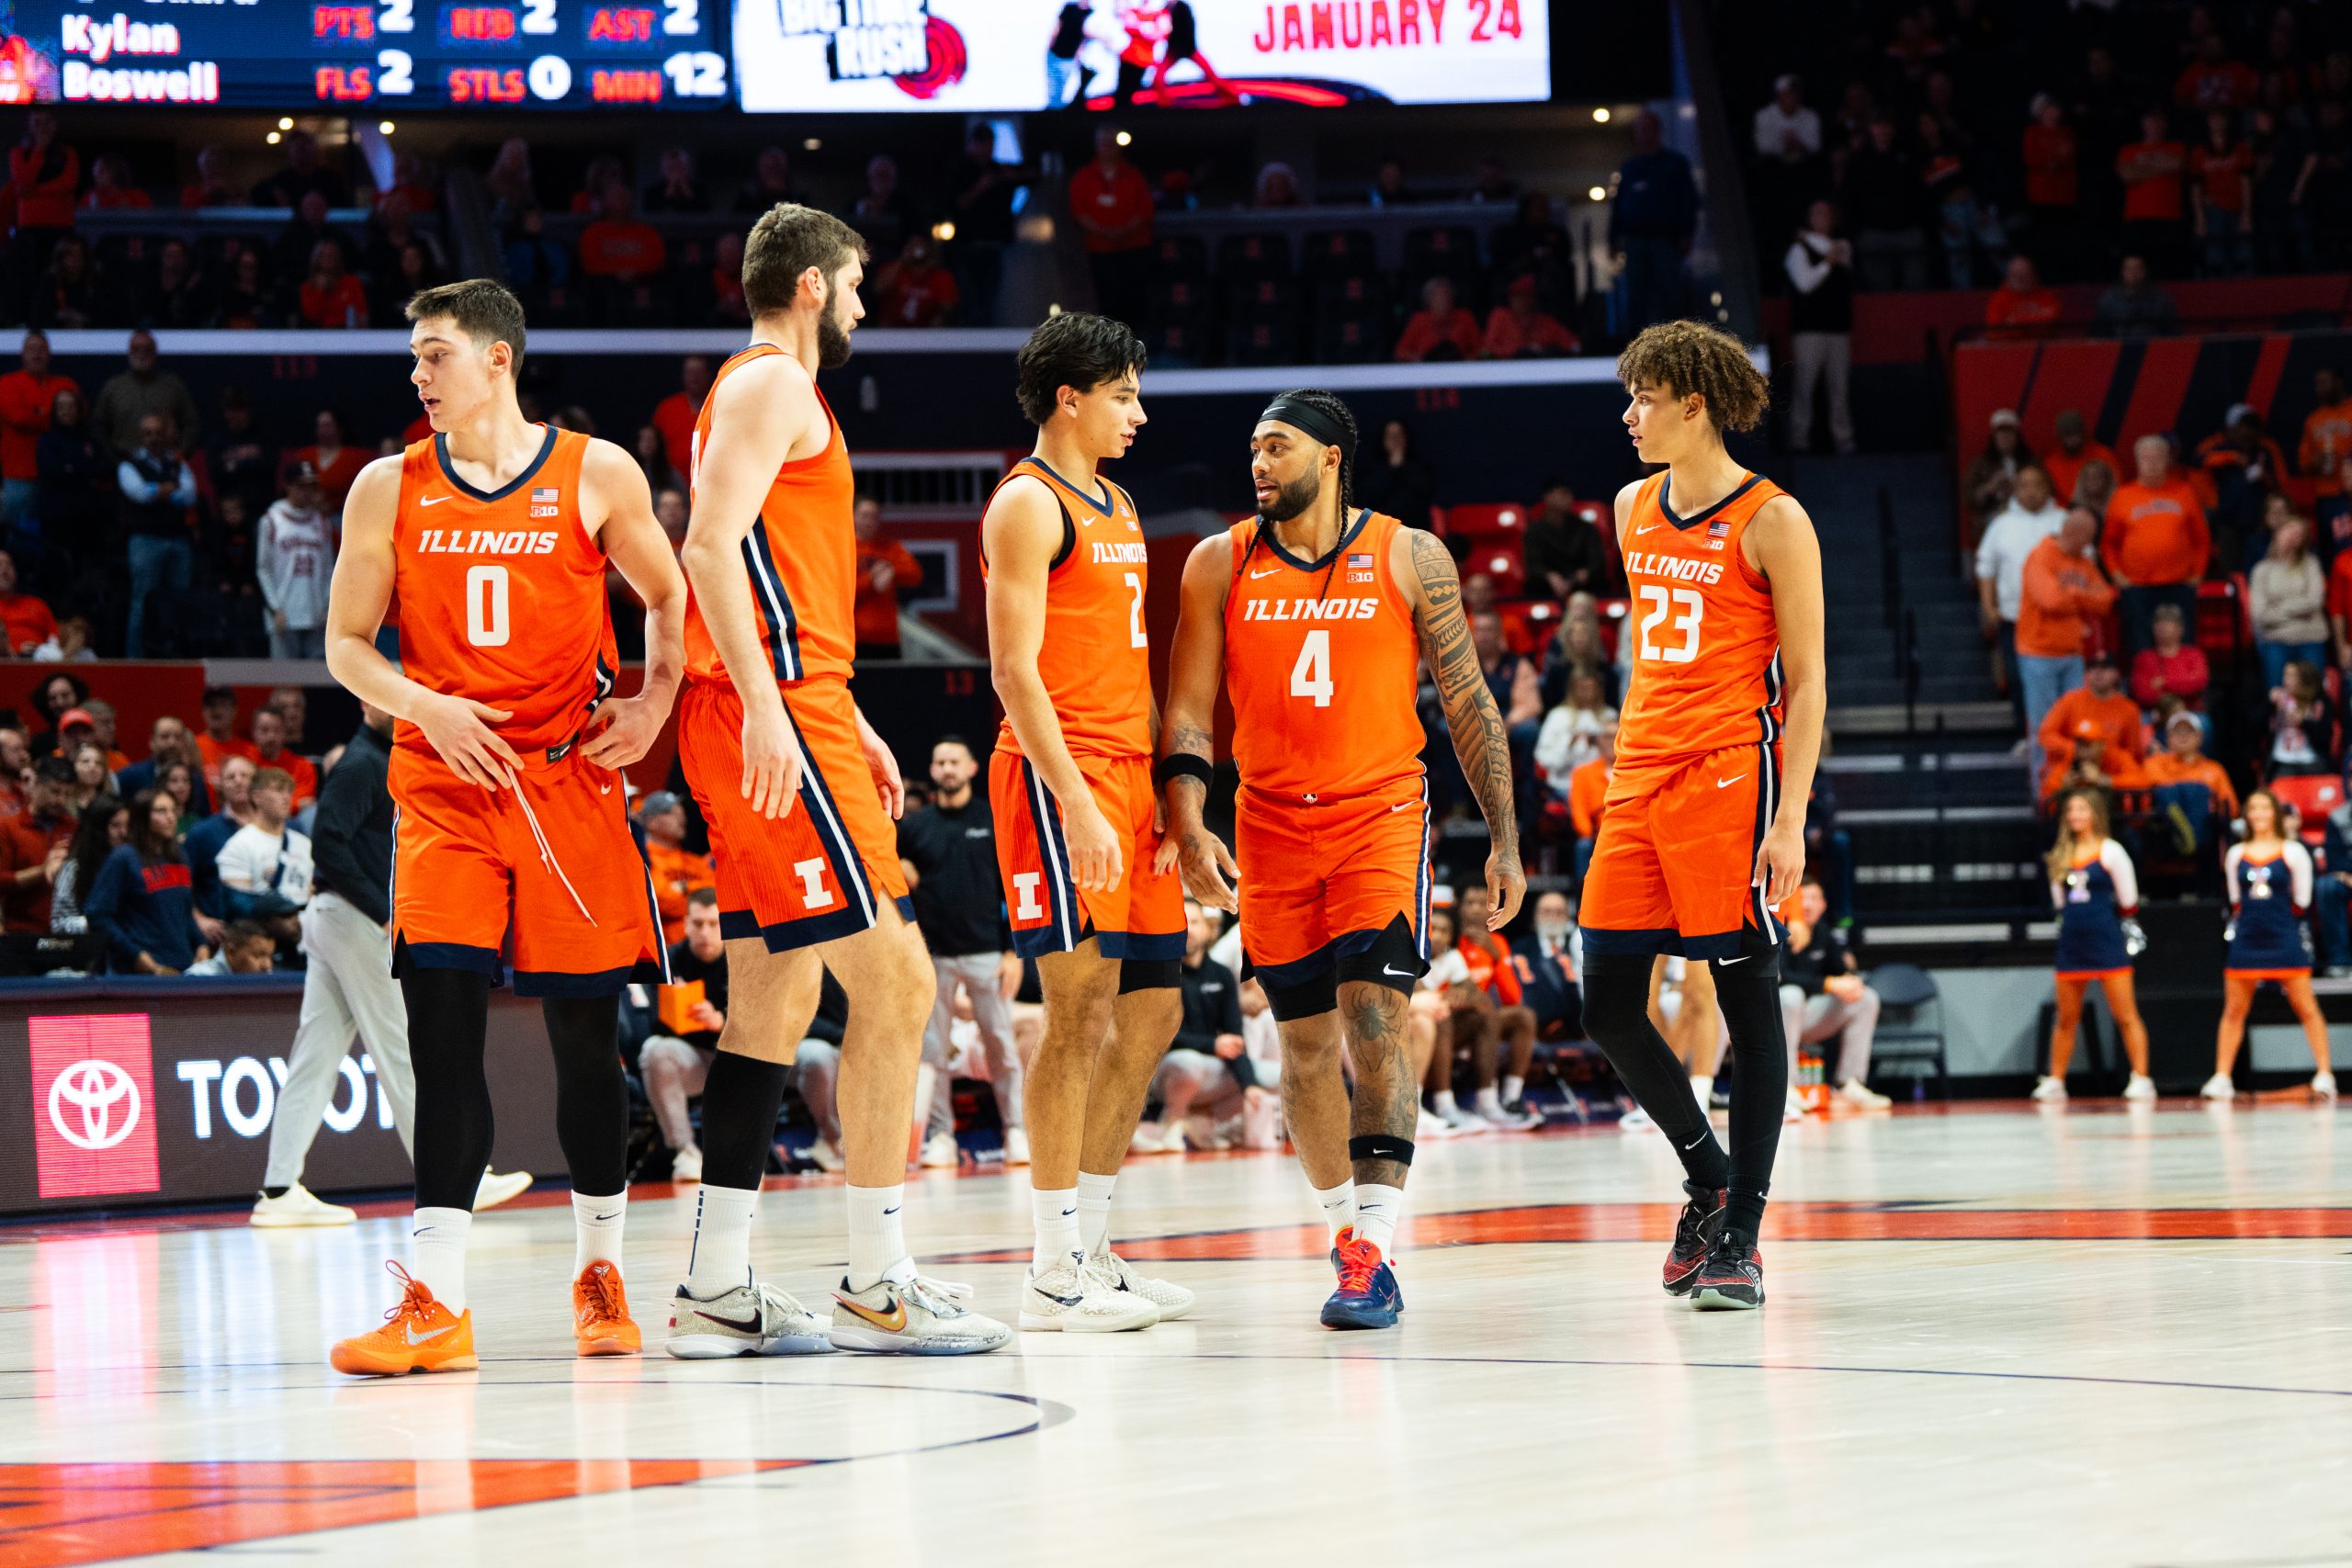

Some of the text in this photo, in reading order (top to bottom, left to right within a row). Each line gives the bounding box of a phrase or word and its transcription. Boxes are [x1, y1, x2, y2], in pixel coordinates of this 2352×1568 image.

[62, 13, 180, 63] Kylan
[314, 0, 413, 38] PTS 2
[450, 0, 557, 39] REB 2
[589, 0, 699, 40] AST 2
[1254, 0, 1521, 51] JANUARY 24
[316, 49, 413, 100] FLS 2
[835, 26, 927, 77] RUSH
[62, 61, 220, 103] Boswell
[449, 55, 571, 102] STLS 0
[593, 51, 726, 102] MIN 12
[418, 529, 559, 555] ILLINOIS
[1092, 542, 1148, 564] ILLINOIS
[1626, 551, 1724, 585] ILLINOIS
[467, 565, 510, 647] 0
[1124, 572, 1148, 649] 2
[1243, 598, 1379, 621] ILLINOIS
[1640, 584, 1704, 663] 23
[1290, 629, 1334, 707] 4
